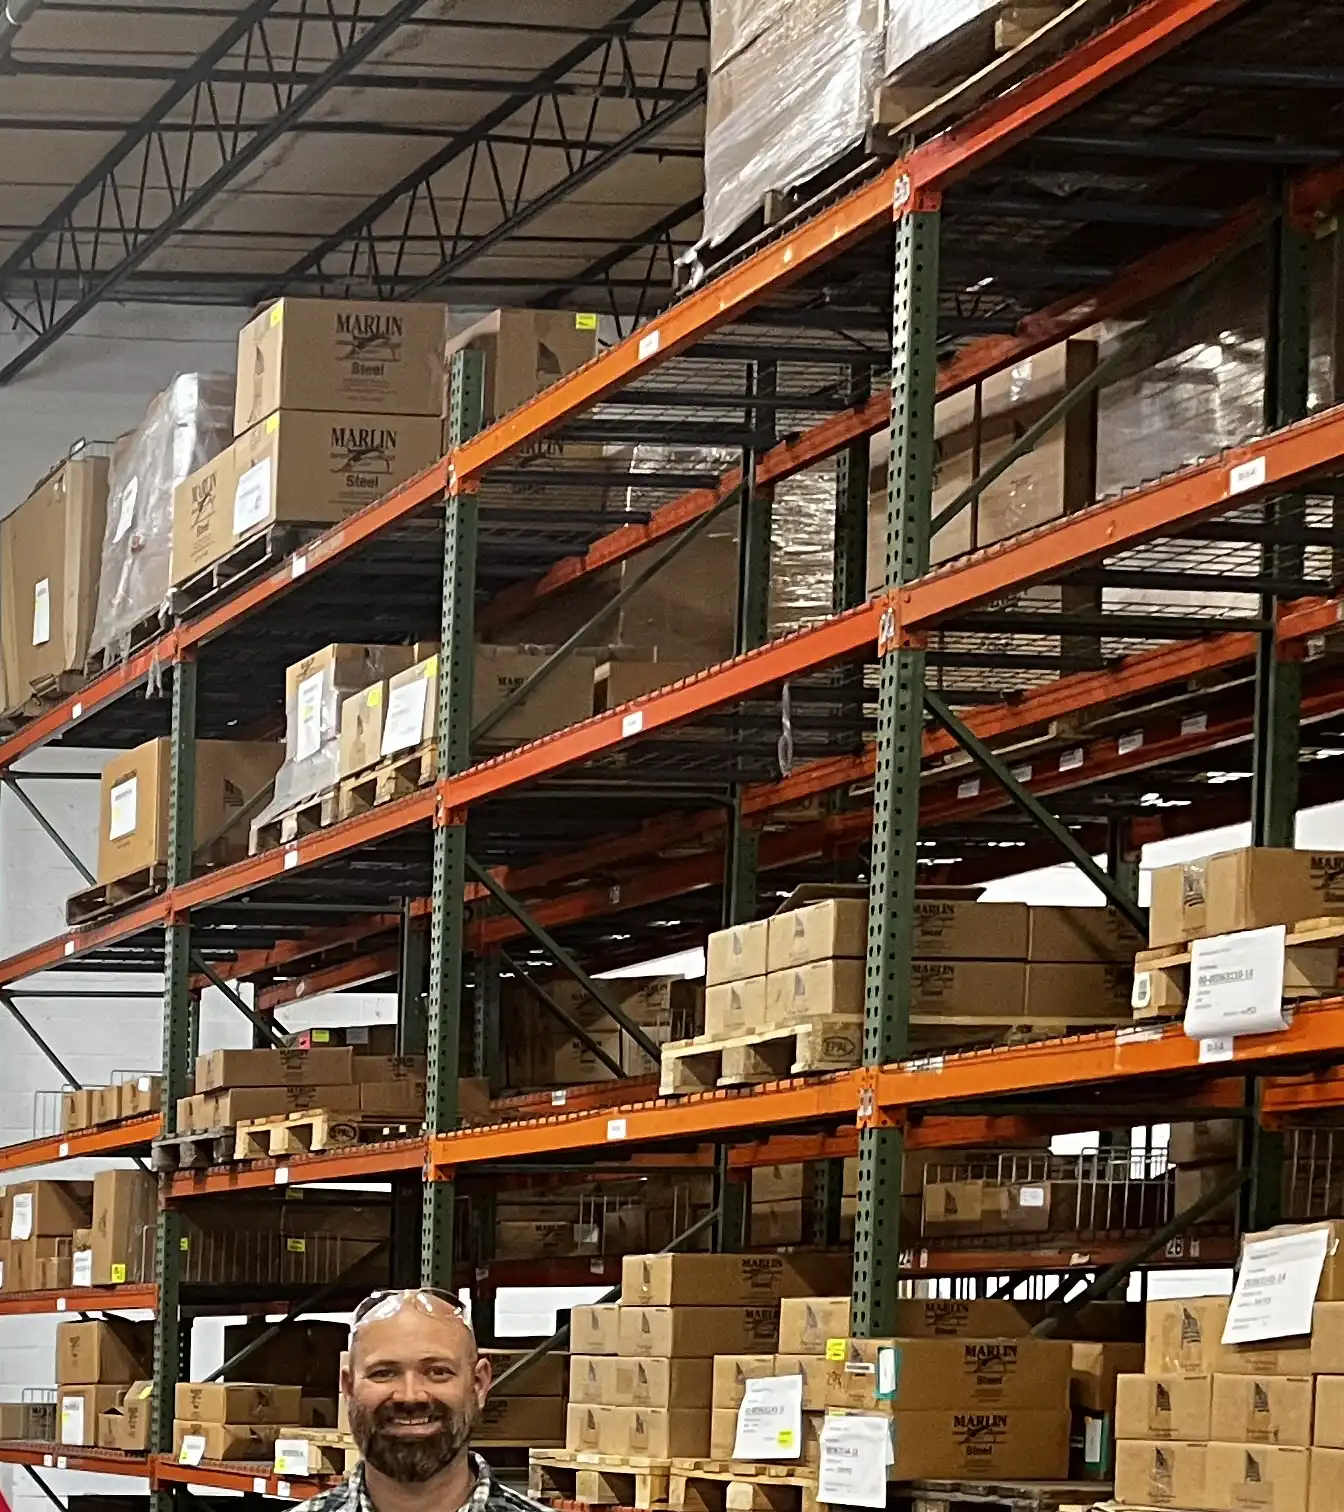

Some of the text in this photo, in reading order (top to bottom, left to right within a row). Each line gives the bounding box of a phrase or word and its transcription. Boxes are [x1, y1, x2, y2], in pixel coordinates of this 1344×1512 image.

[335, 313, 404, 336] MARLIN
[350, 361, 385, 376] Steel
[330, 427, 397, 449] MARLIN
[345, 475, 379, 488] Steel
[964, 1344, 1018, 1357] MARLIN
[953, 1415, 1008, 1427] MARLIN
